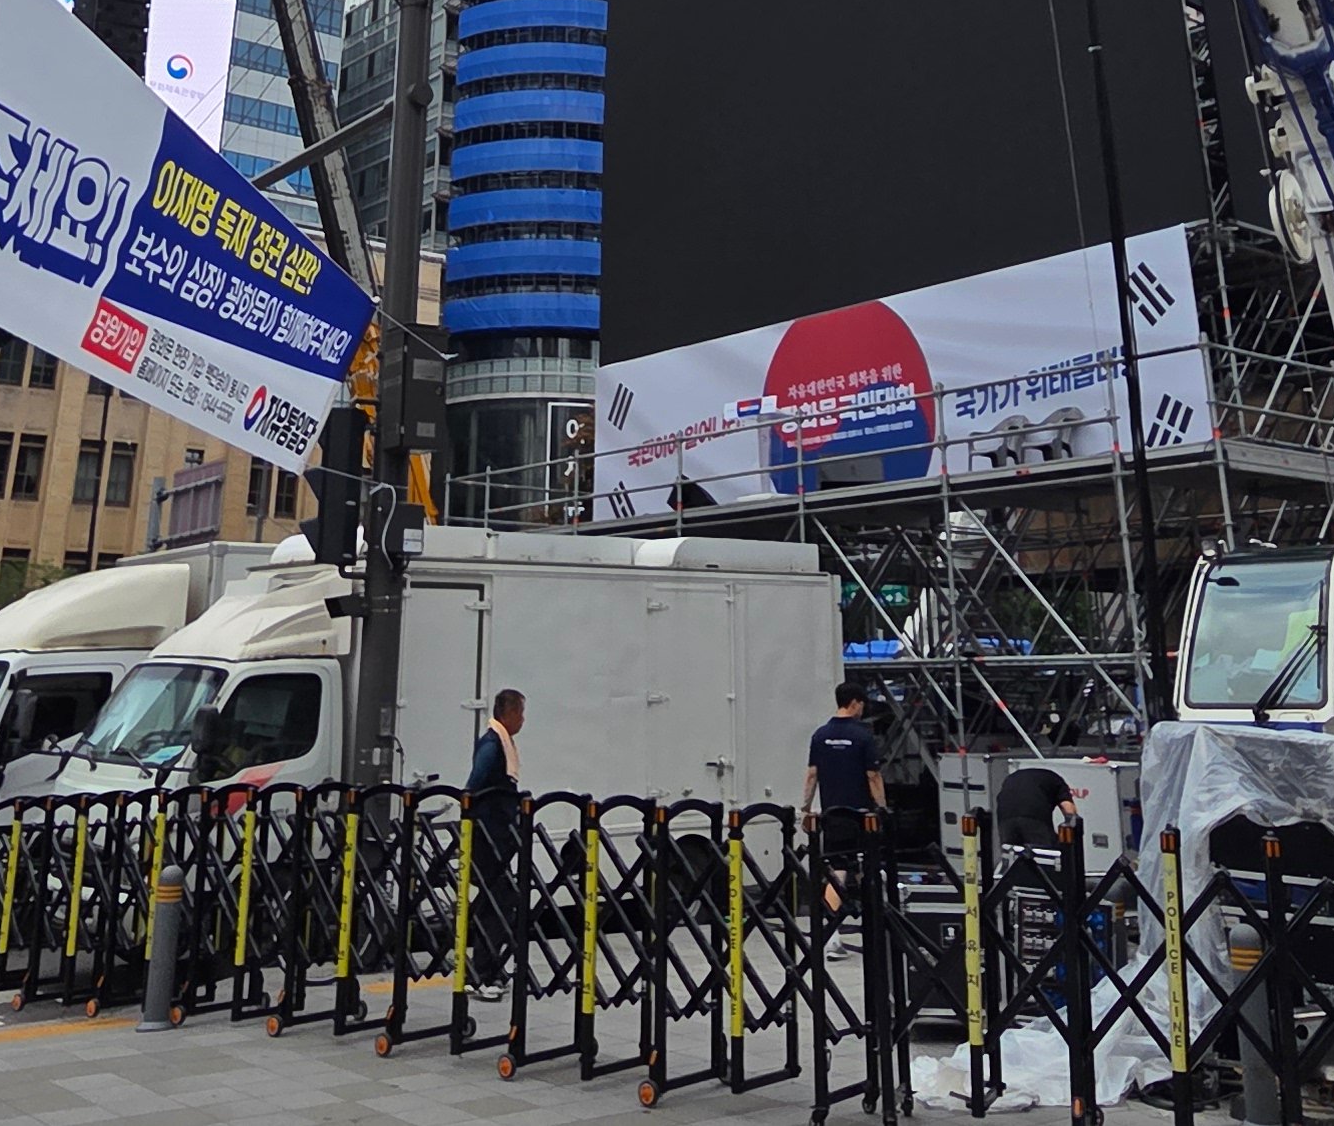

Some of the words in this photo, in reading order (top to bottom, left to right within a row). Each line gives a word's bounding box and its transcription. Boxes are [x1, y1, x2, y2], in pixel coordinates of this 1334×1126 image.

[152, 160, 218, 236] 이재명
[215, 198, 257, 261] 독재
[248, 221, 290, 278] 정권
[280, 244, 322, 294] 심판!
[125, 226, 188, 293] 보수의
[180, 255, 227, 310] 심장!
[218, 275, 282, 333] 광화문이
[273, 301, 353, 364] 함께해주세요!
[90, 308, 142, 362] 당원가입
[255, 394, 320, 456] 자유통일당
[955, 381, 1020, 420] 국가가
[1167, 892, 1180, 975] POLICE
[1172, 991, 1184, 1048] LINE
